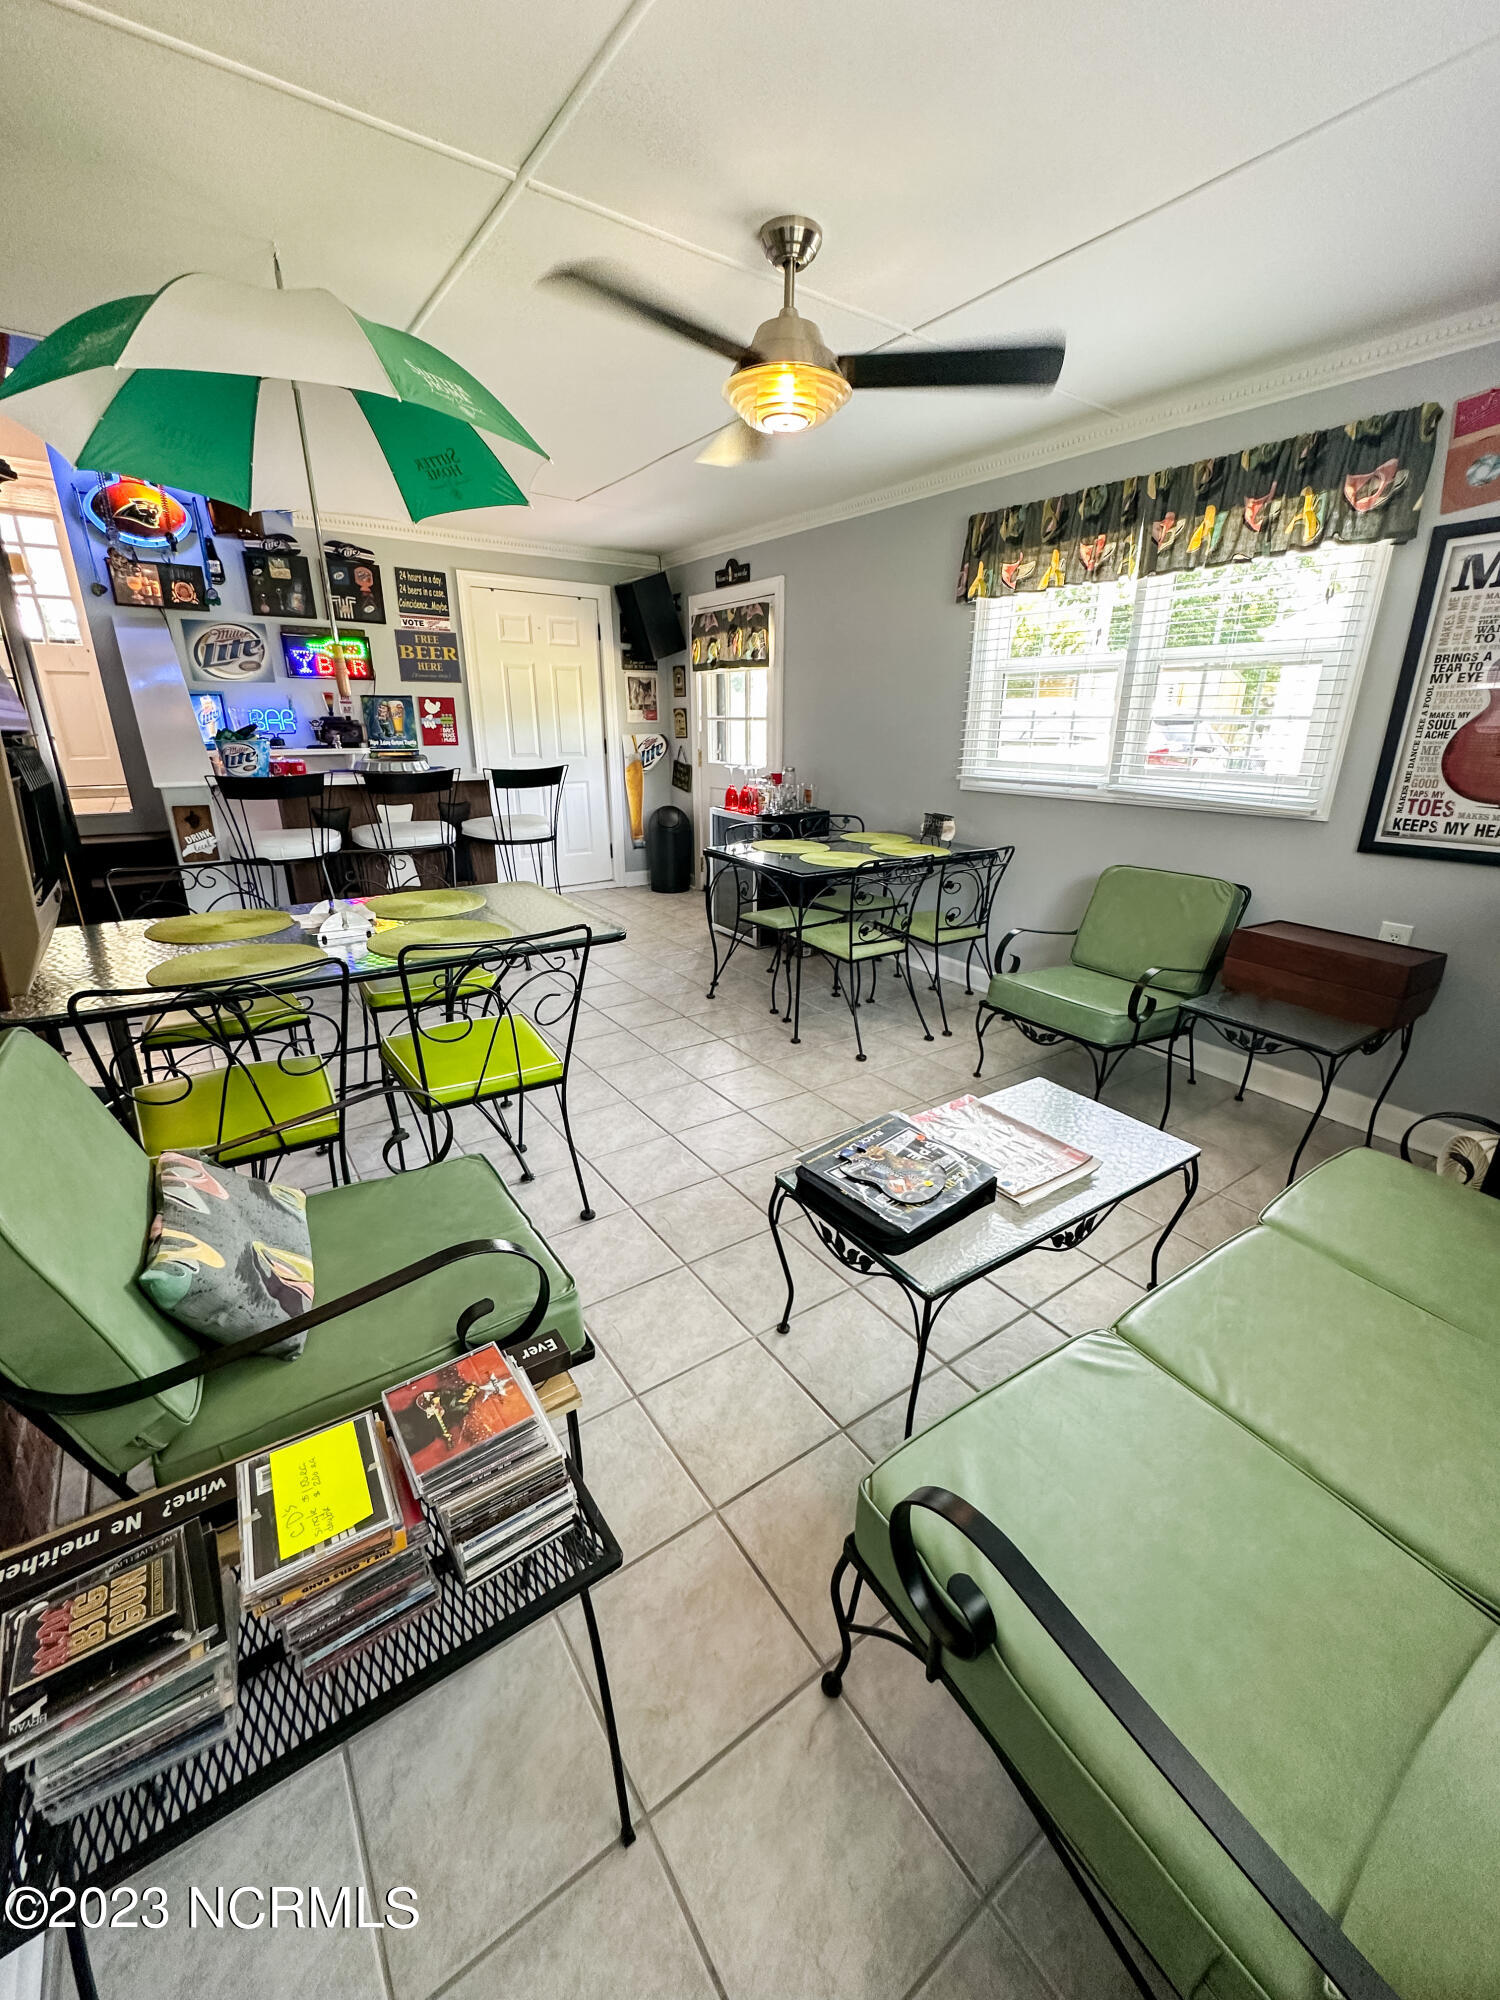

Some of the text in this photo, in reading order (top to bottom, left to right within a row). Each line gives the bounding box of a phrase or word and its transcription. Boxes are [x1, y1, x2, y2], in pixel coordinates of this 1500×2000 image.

[399, 570, 407, 581] 24
[407, 572, 422, 583] hours
[422, 574, 428, 583] in
[399, 584, 407, 594] 24
[407, 586, 422, 596] beers
[422, 588, 428, 596] in
[402, 619, 425, 627] VOTE
[414, 634, 439, 644] FREE
[1474, 633, 1496, 644] TO
[399, 644, 459, 661] BEER
[1434, 651, 1492, 664] BRINGS A
[417, 661, 444, 672] HERE
[1433, 661, 1484, 674] TEAR TO
[1429, 672, 1484, 684] MY EYE
[1423, 685, 1435, 709] FOOL
[249, 708, 297, 732] BAR
[1427, 719, 1458, 731] SOUL
[1415, 718, 1426, 739] LIKE
[1424, 731, 1450, 739] ACHE
[1408, 740, 1421, 769] DANCE
[1404, 770, 1413, 784] ME
[1411, 778, 1440, 789] GOOD
[1397, 785, 1409, 814] MAKES
[1410, 790, 1445, 799] TAPS MY
[1407, 799, 1456, 818] TOES
[1457, 812, 1490, 820] MAKES
[1392, 818, 1438, 834] KEEPS
[1443, 821, 1470, 836] MY
[184, 828, 212, 844] DRINK
[522, 1338, 558, 1360] Ever
[162, 1477, 227, 1517] wine?
[111, 1511, 142, 1535] Ne
[374, 1549, 391, 1562] THE
[301, 1573, 330, 1594] BAND
[109, 1564, 147, 1636] GUN
[69, 1585, 108, 1658] BIG
